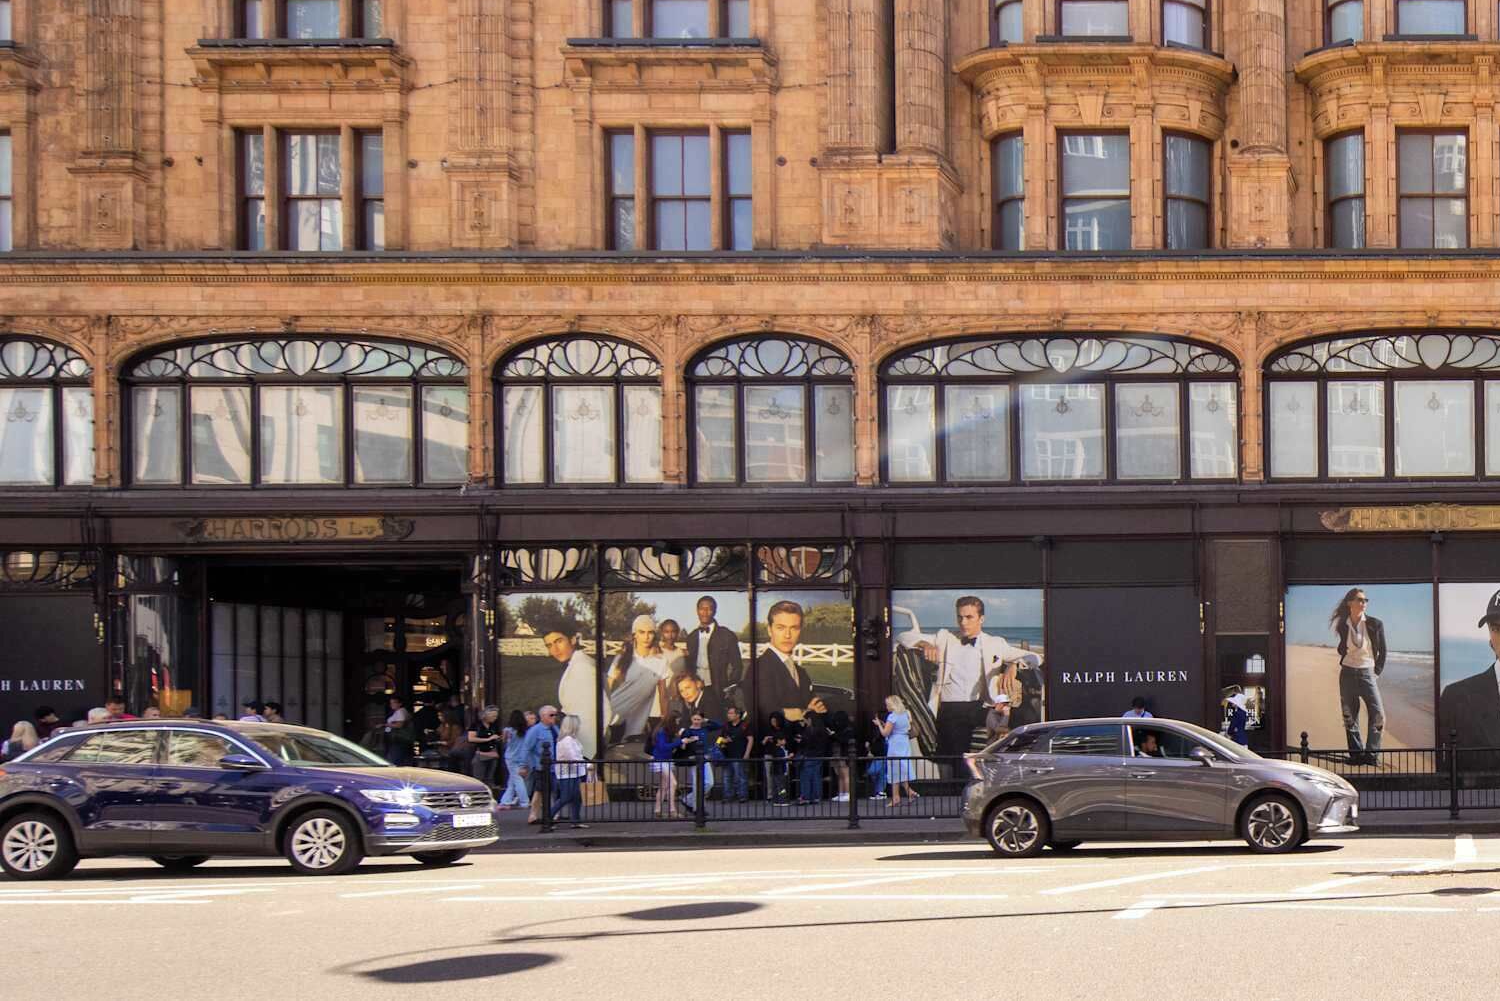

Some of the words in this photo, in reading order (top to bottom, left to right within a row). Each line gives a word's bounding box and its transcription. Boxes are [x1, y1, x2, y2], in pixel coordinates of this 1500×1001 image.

[1353, 509, 1479, 528] HARRODS
[209, 518, 338, 539] HARRODS
[1062, 671, 1115, 683] RALPH
[1124, 670, 1188, 682] LAUREN
[20, 679, 85, 691] LAUREN
